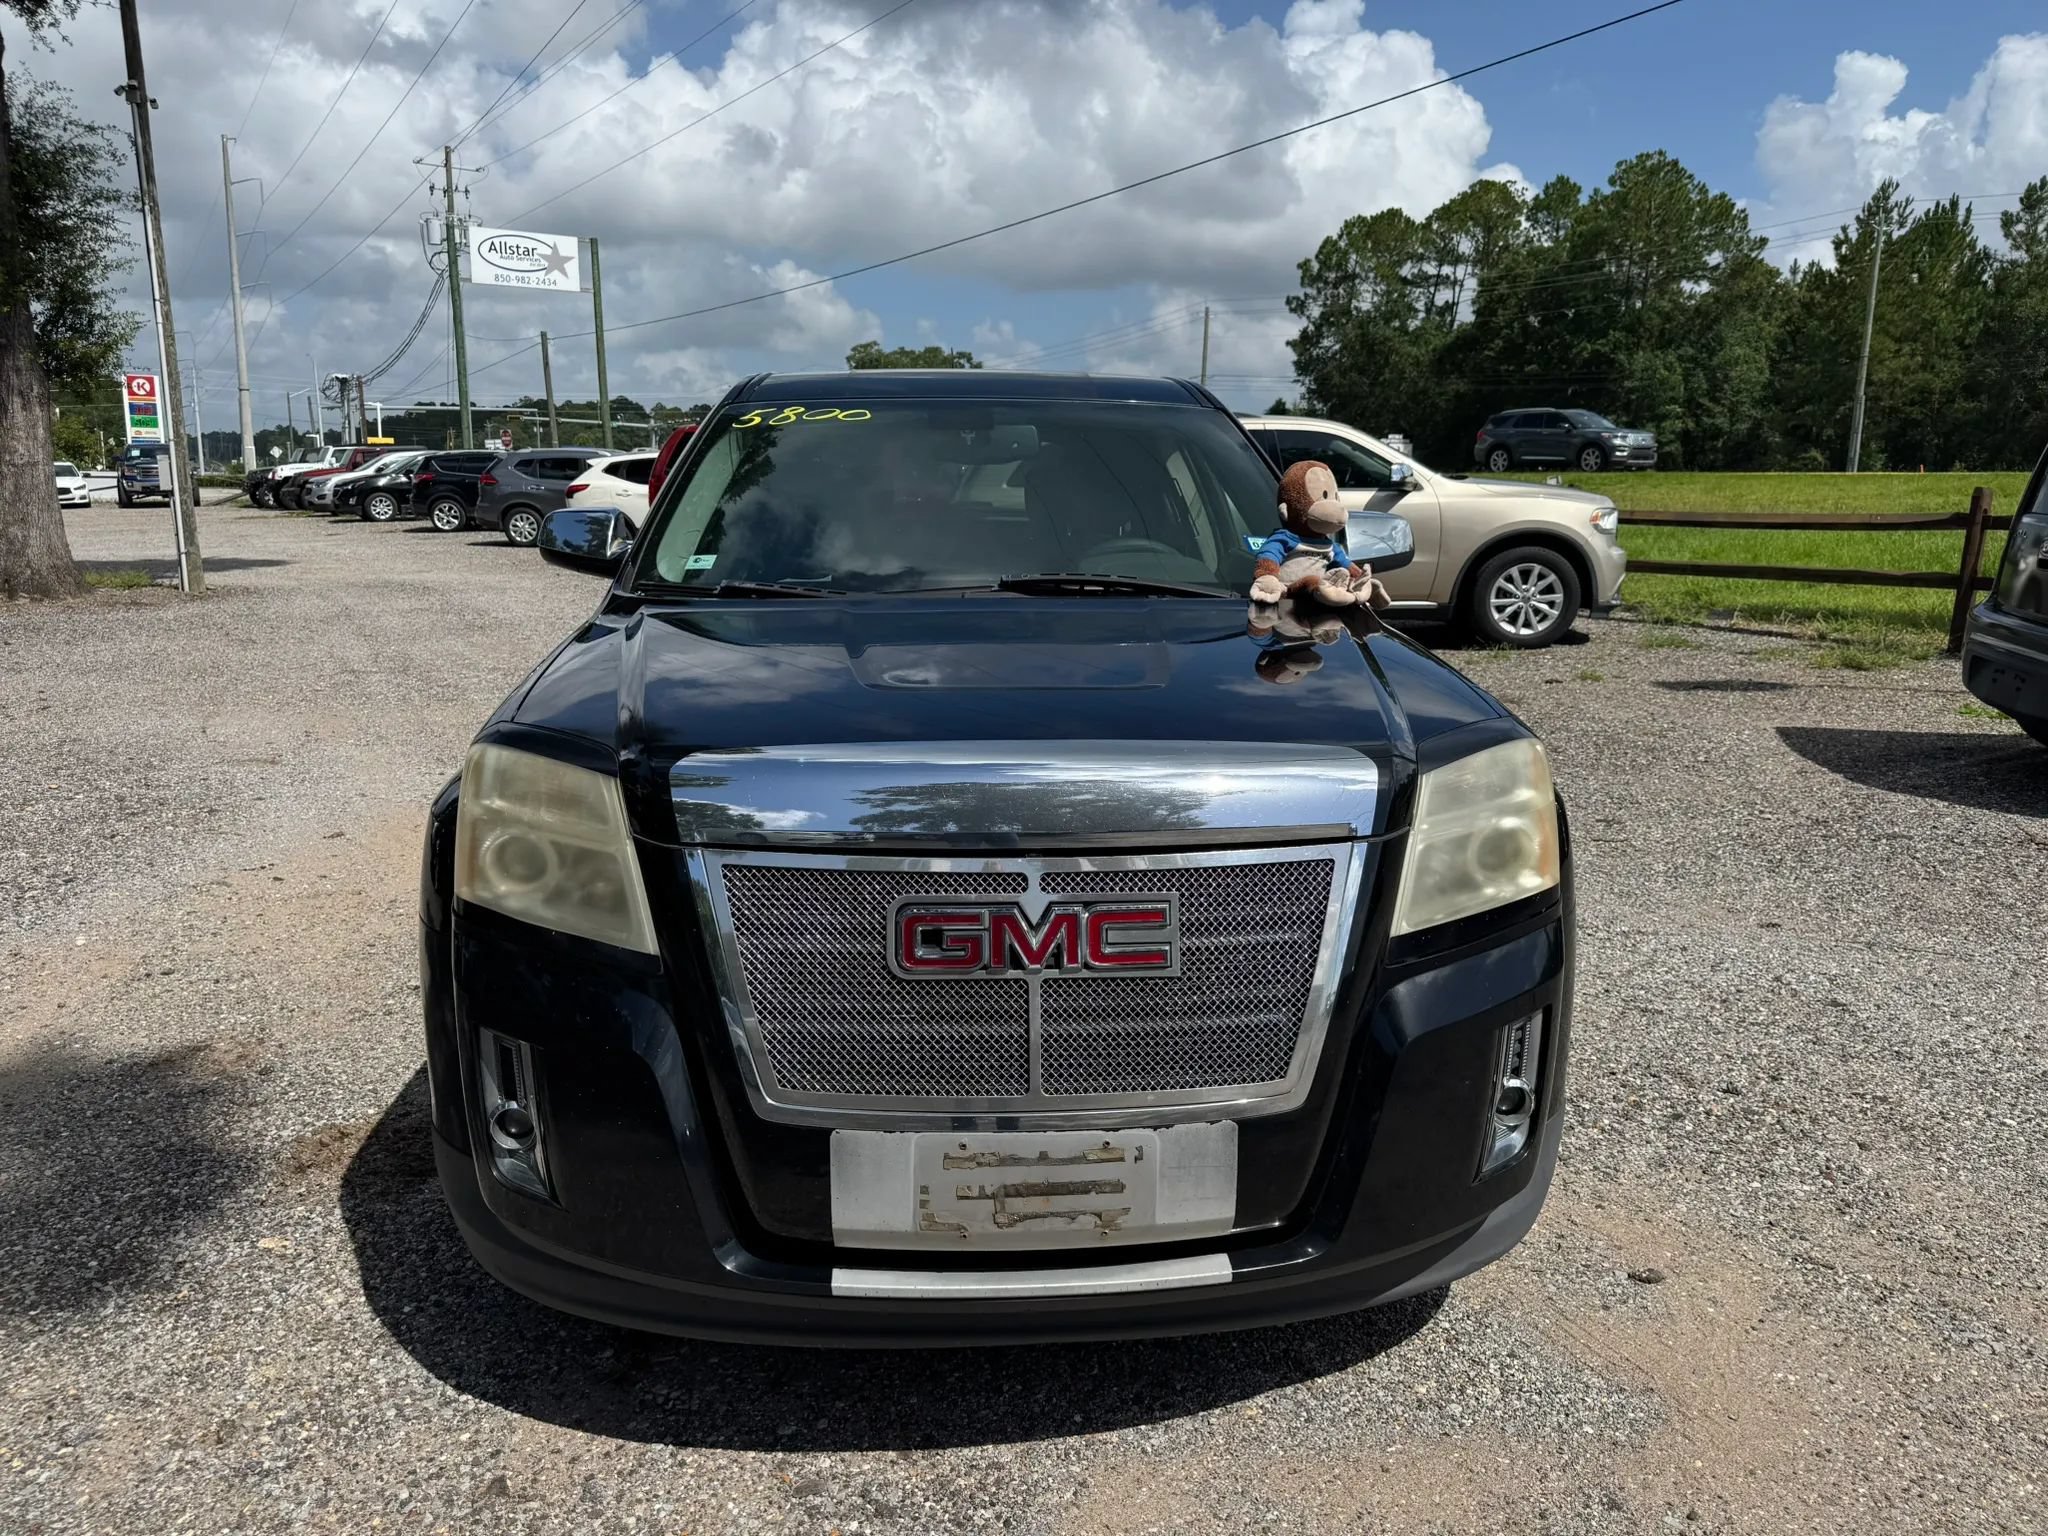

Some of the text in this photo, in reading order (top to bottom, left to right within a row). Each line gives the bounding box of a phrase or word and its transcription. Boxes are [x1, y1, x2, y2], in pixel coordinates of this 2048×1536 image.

[488, 240, 538, 257] Allstar
[516, 255, 542, 263] Services
[494, 274, 557, 286] 850-982-2434
[137, 382, 150, 393] K
[732, 406, 872, 428] 5800
[897, 903, 1172, 973] GMC
